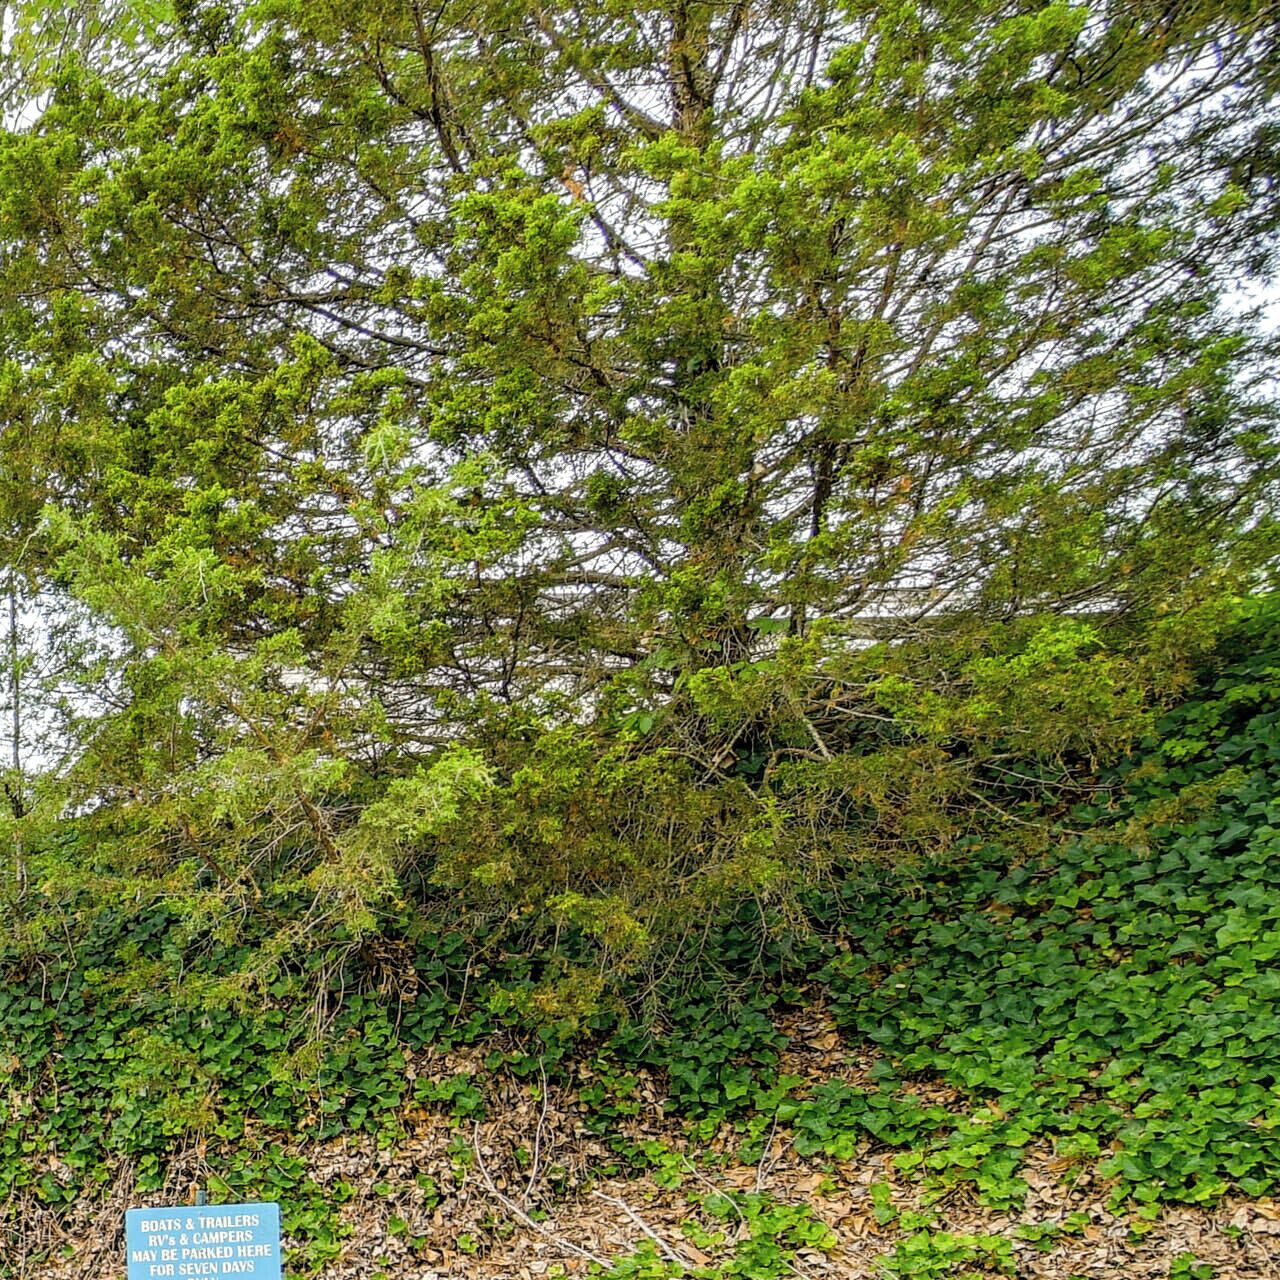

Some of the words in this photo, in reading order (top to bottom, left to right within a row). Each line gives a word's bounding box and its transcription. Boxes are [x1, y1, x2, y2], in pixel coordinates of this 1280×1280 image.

[141, 1219, 181, 1232] BOATS
[186, 1218, 194, 1230] &
[199, 1215, 259, 1229] TRAILERS
[149, 1235, 175, 1246] RV's
[180, 1233, 188, 1244] &
[193, 1230, 252, 1244] CAMPERS
[132, 1251, 157, 1262] MAY
[162, 1250, 177, 1261] BE
[182, 1247, 232, 1259] PARKED
[238, 1244, 271, 1256] HERE
[150, 1264, 174, 1276] FOR
[179, 1262, 217, 1275] SEVEN
[223, 1261, 254, 1273] DAYS
